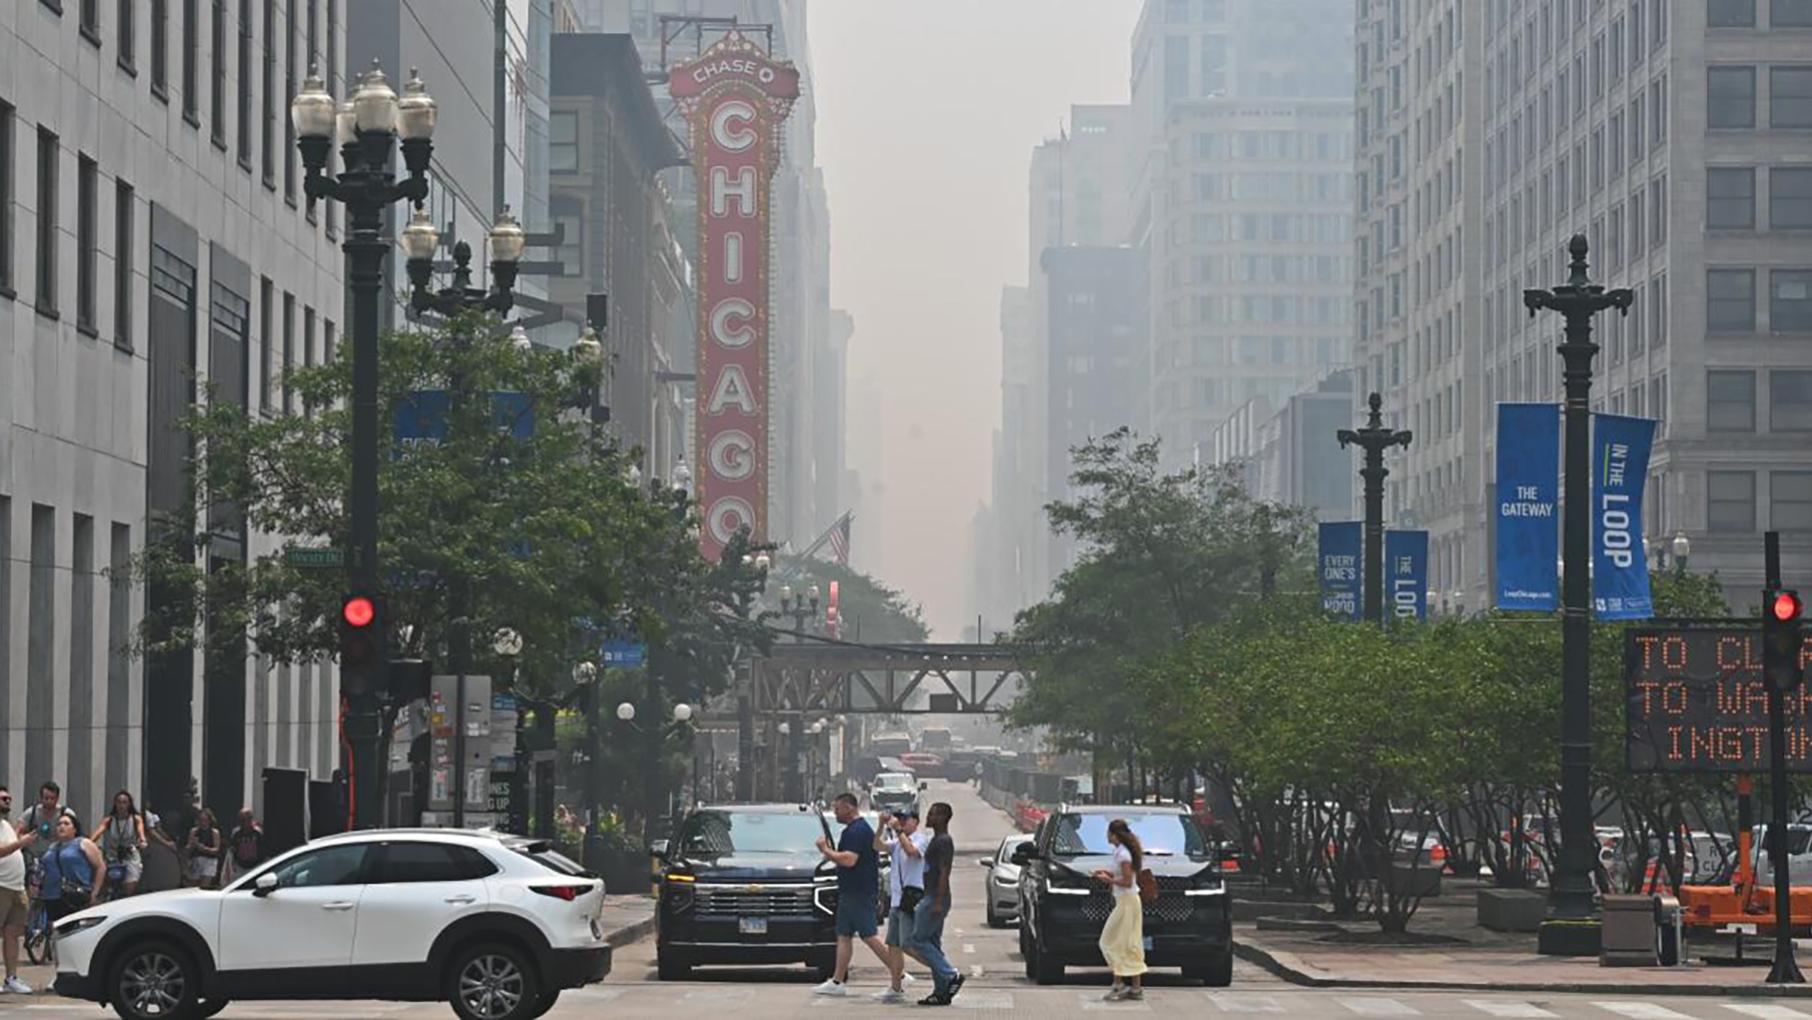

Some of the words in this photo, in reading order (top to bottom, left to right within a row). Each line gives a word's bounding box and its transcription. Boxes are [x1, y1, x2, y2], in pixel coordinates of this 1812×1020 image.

[693, 59, 757, 83] CHASE
[707, 100, 758, 546] CHICAGO
[1611, 443, 1629, 458] IN
[1609, 461, 1627, 486] THE
[1517, 486, 1538, 499] THE
[1501, 504, 1553, 517] GATEWAY
[1603, 493, 1633, 568] LOOP
[1324, 555, 1356, 566] EVERY
[1394, 579, 1417, 618] LOO
[1635, 636, 1687, 669] TO
[1635, 682, 1687, 714] TO
